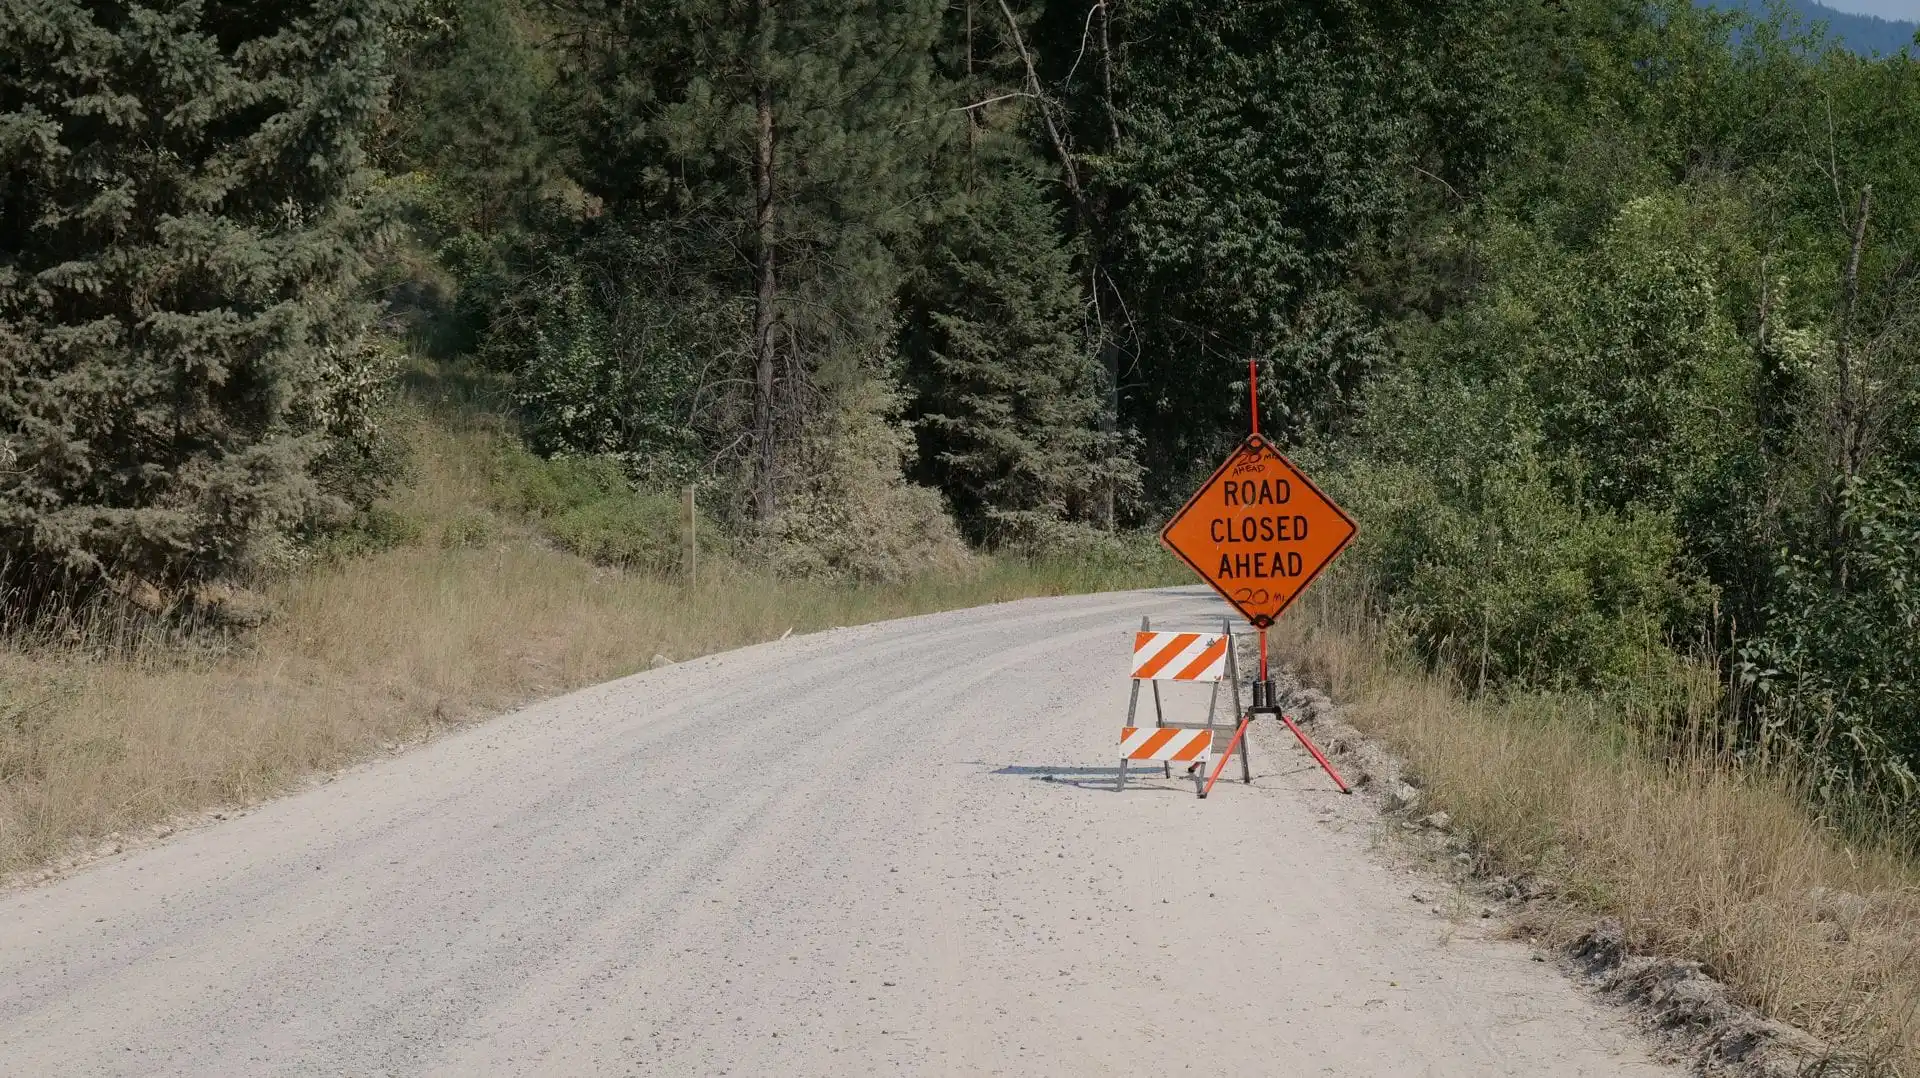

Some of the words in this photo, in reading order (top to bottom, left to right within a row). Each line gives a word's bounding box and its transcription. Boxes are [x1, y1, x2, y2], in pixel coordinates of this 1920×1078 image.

[1237, 453, 1260, 466] 20
[1232, 465, 1265, 477] AHEAD
[1224, 479, 1291, 506] ROAD
[1211, 516, 1308, 543] CLOSED
[1218, 552, 1303, 579] AHEAD
[1235, 587, 1269, 605] 20
